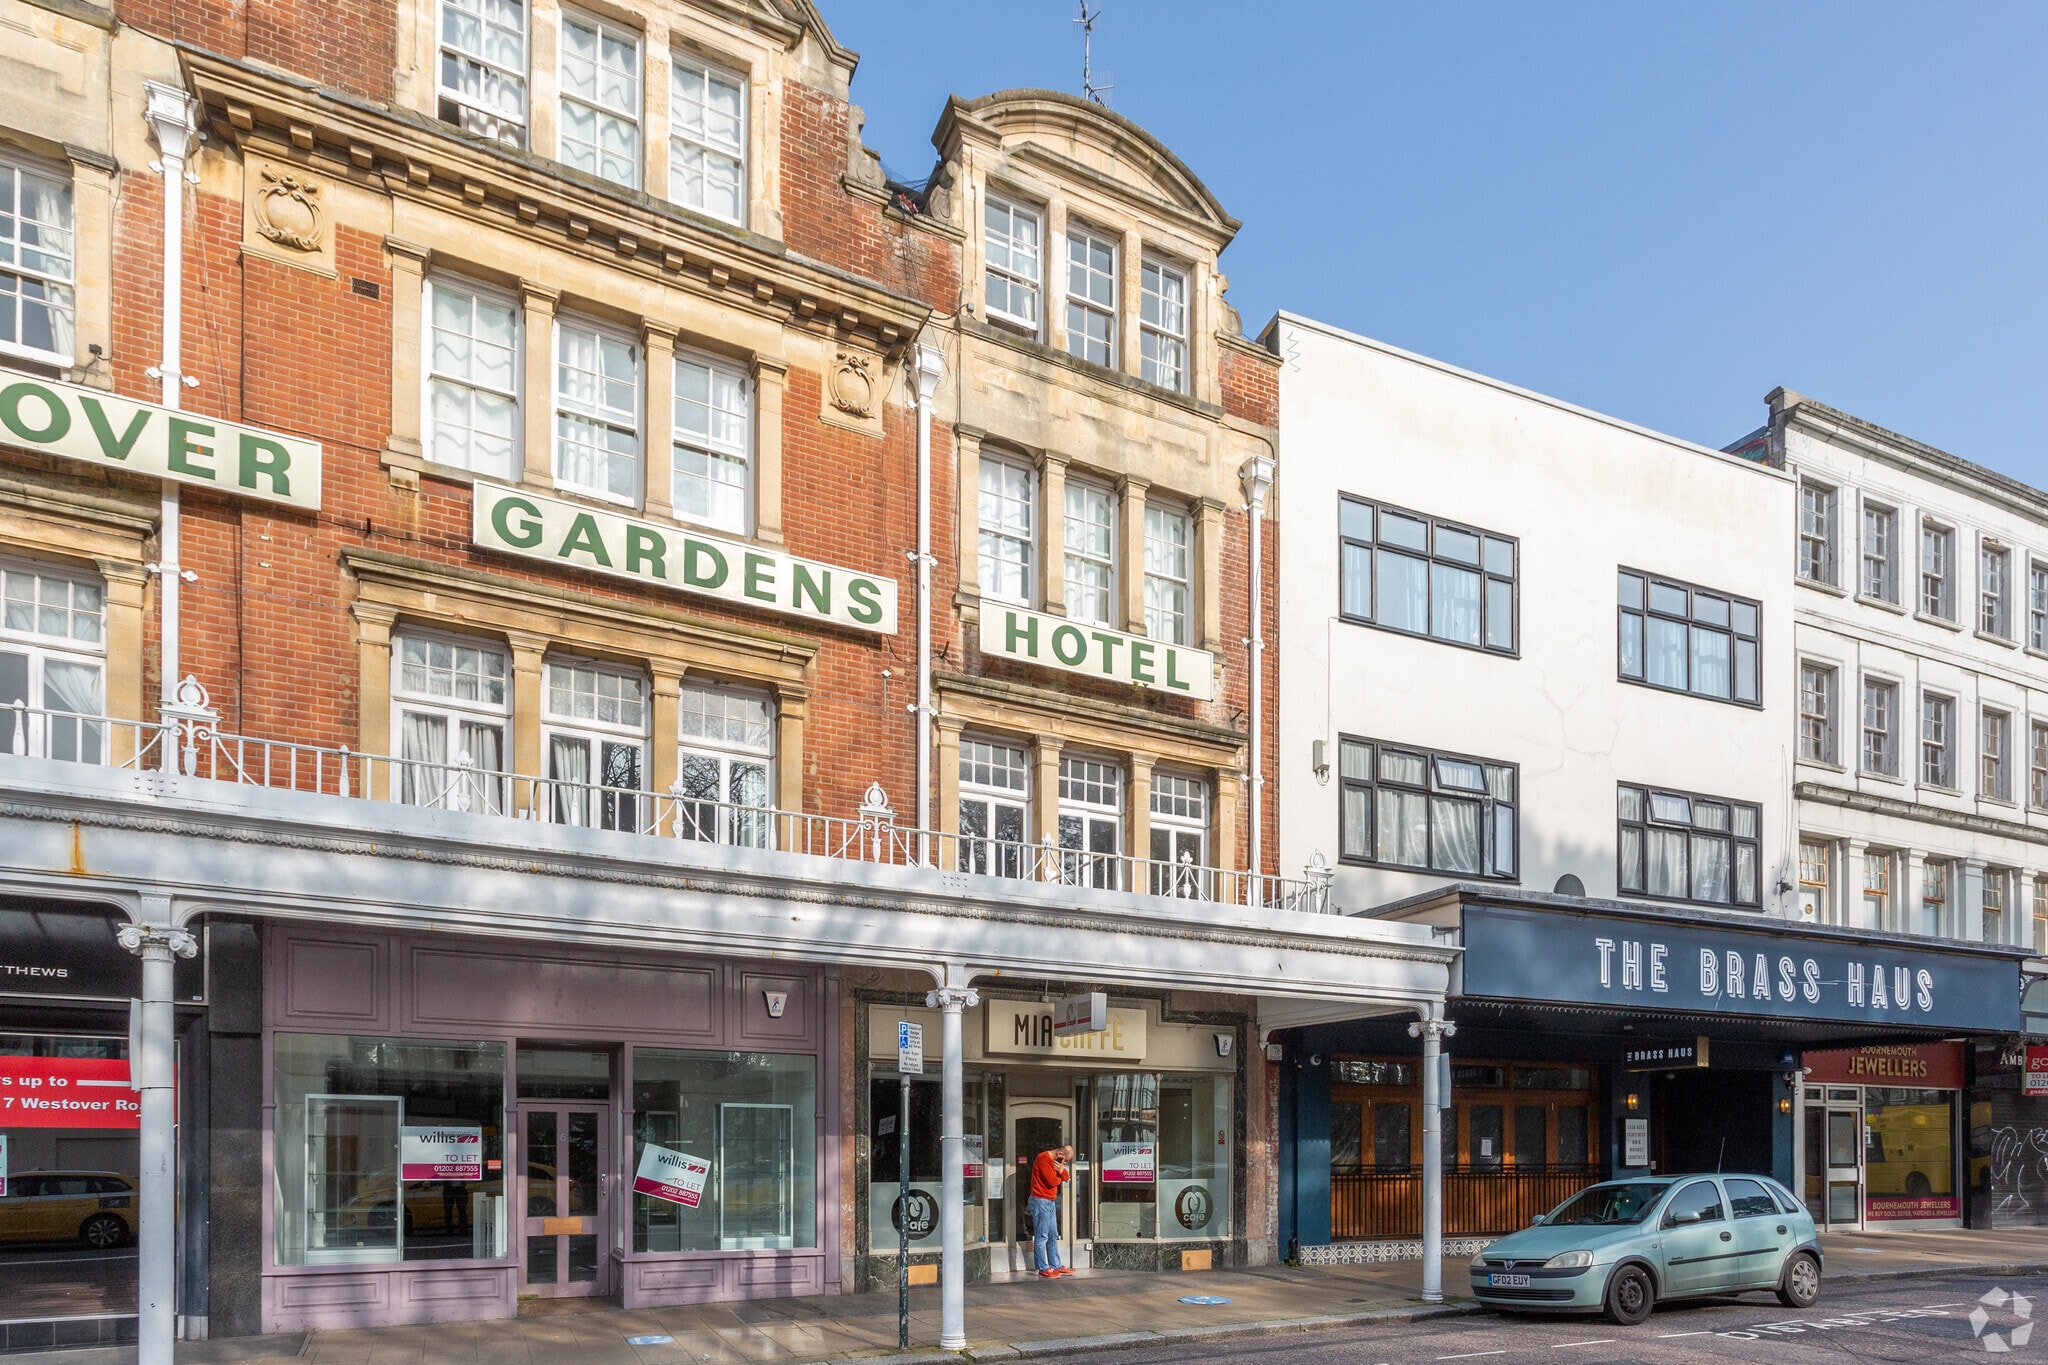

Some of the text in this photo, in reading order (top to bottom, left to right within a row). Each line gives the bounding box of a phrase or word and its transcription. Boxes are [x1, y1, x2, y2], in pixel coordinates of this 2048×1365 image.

[0, 382, 292, 497] OVER
[491, 497, 883, 625] GARDENS
[1006, 611, 1190, 691] HOTEL
[1595, 938, 1933, 1012] THE BRASS HAUS
[1014, 1014, 1053, 1047] MIA
[1634, 1050, 1664, 1061] BRASS
[1668, 1047, 1692, 1058] HAUS
[1848, 1056, 1927, 1077] JEWELLERS
[19, 1078, 42, 1088] up
[48, 1076, 68, 1086] to
[3, 1097, 15, 1109] 7
[20, 1098, 110, 1110] Westover
[420, 1131, 456, 1143] willis
[1113, 1145, 1137, 1155] willis
[444, 1154, 478, 1162] TO LET
[657, 1154, 688, 1170] willis
[661, 1184, 678, 1195] 01202
[672, 1178, 702, 1190] TO LET
[1872, 1200, 1951, 1210] BOURNEMOUTH JEWELLERS
[1492, 1275, 1529, 1286] GF02 EUY
